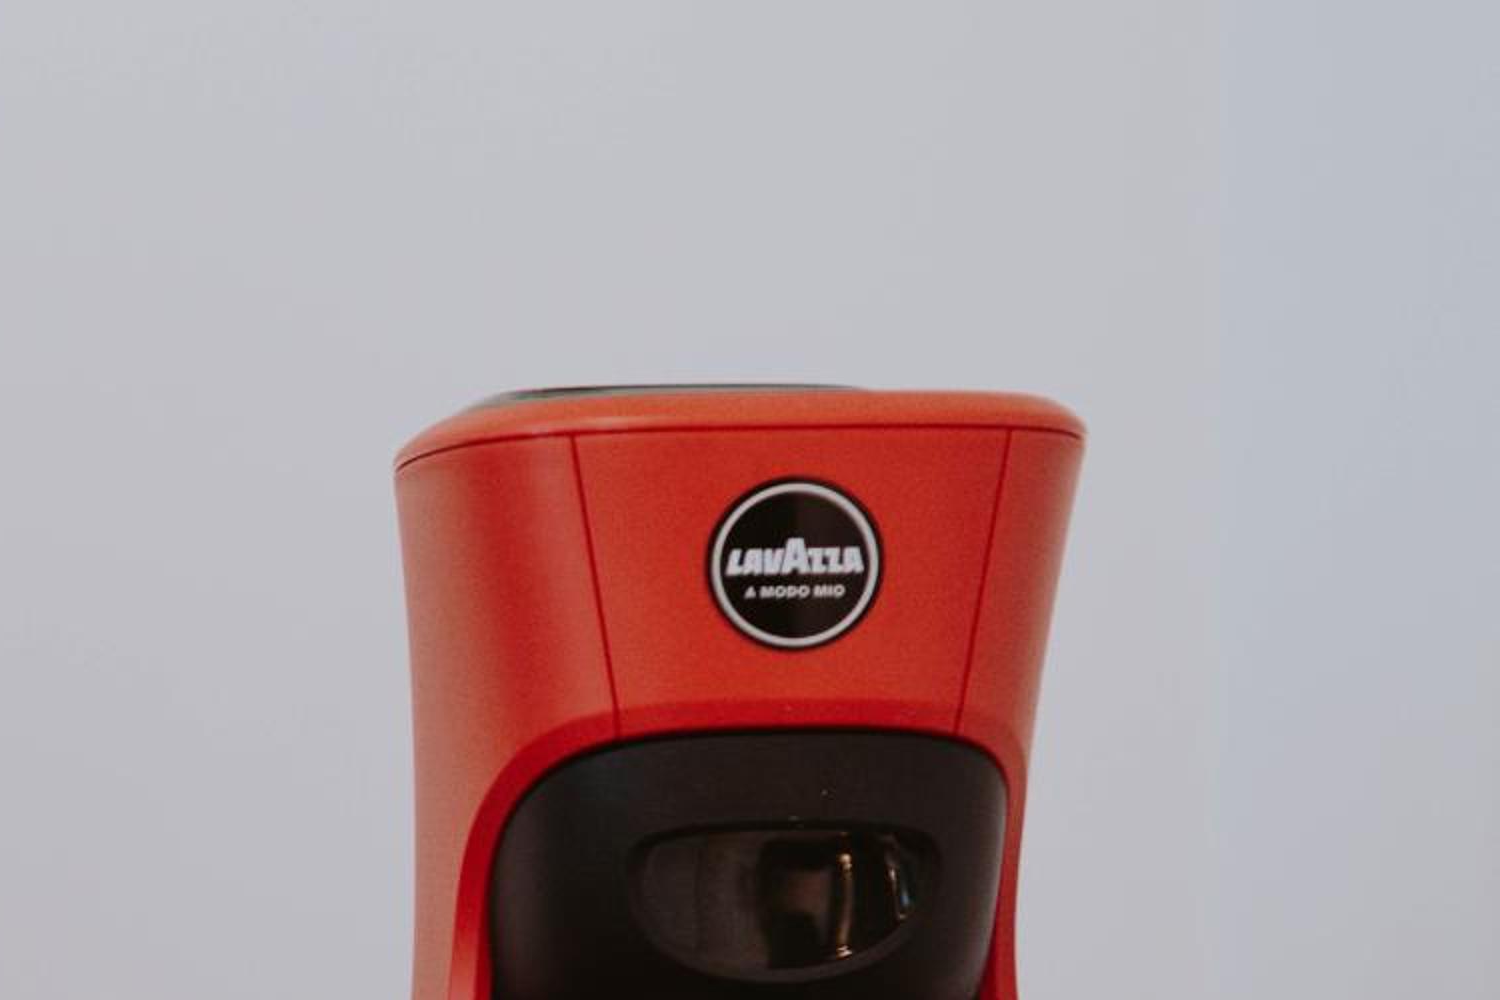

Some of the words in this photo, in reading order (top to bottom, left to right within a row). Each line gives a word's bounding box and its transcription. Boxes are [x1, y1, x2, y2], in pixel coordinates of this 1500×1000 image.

[725, 538, 865, 576] LAVAZZA
[744, 587, 757, 599] A
[759, 586, 810, 599] MODO
[813, 584, 846, 598] MIO
